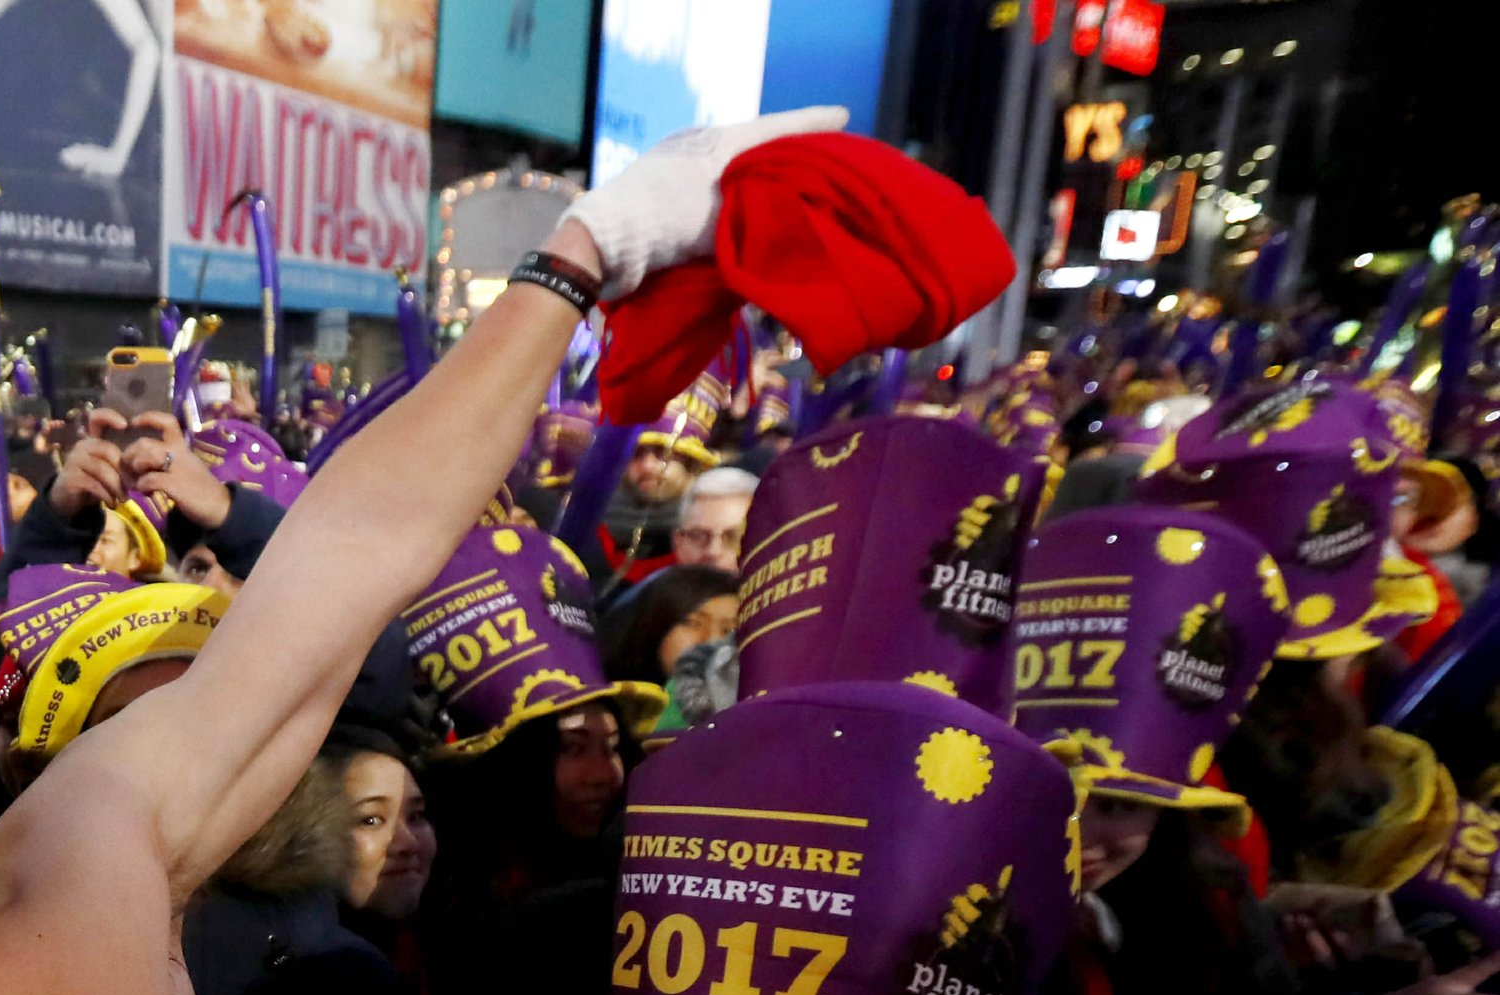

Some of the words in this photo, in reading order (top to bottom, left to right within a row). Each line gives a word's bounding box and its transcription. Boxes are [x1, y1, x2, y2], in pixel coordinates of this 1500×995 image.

[178, 62, 426, 273] WAITRESS
[444, 580, 509, 613] SQUARE
[486, 593, 517, 612] EVE
[1038, 594, 1131, 616] SQUARE
[0, 591, 121, 650] RIUMP
[79, 623, 123, 660] New
[123, 605, 188, 632] Year's
[193, 607, 221, 629] Ev
[1082, 616, 1129, 634] EVE
[420, 607, 537, 692] 2017
[1014, 640, 1127, 690] 017
[1159, 649, 1227, 681] planet
[623, 834, 703, 861] TIMES
[706, 839, 865, 878] SQUARE
[621, 873, 664, 895] NEW
[666, 874, 777, 906] YEAR'S
[778, 885, 856, 917] EVE
